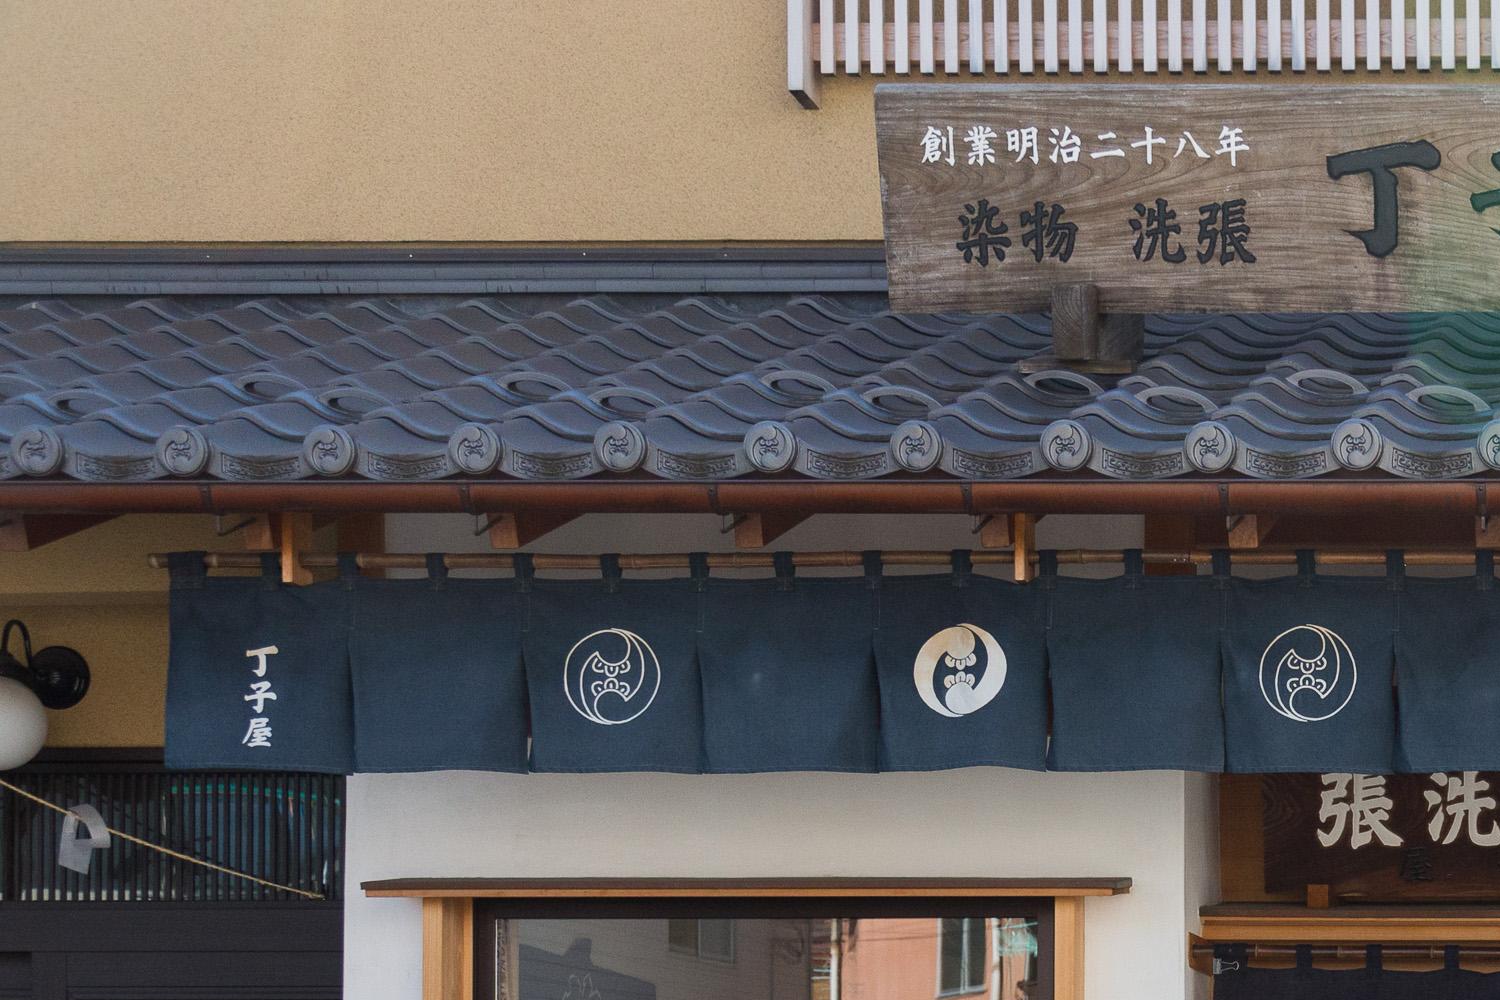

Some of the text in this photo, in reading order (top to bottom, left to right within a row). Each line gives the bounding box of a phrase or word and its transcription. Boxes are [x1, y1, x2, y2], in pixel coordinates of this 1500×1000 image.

[919, 125, 1250, 167] 創業明治二十八年
[956, 197, 1257, 267] 染物 洗張
[241, 645, 279, 748] 丁子屋
